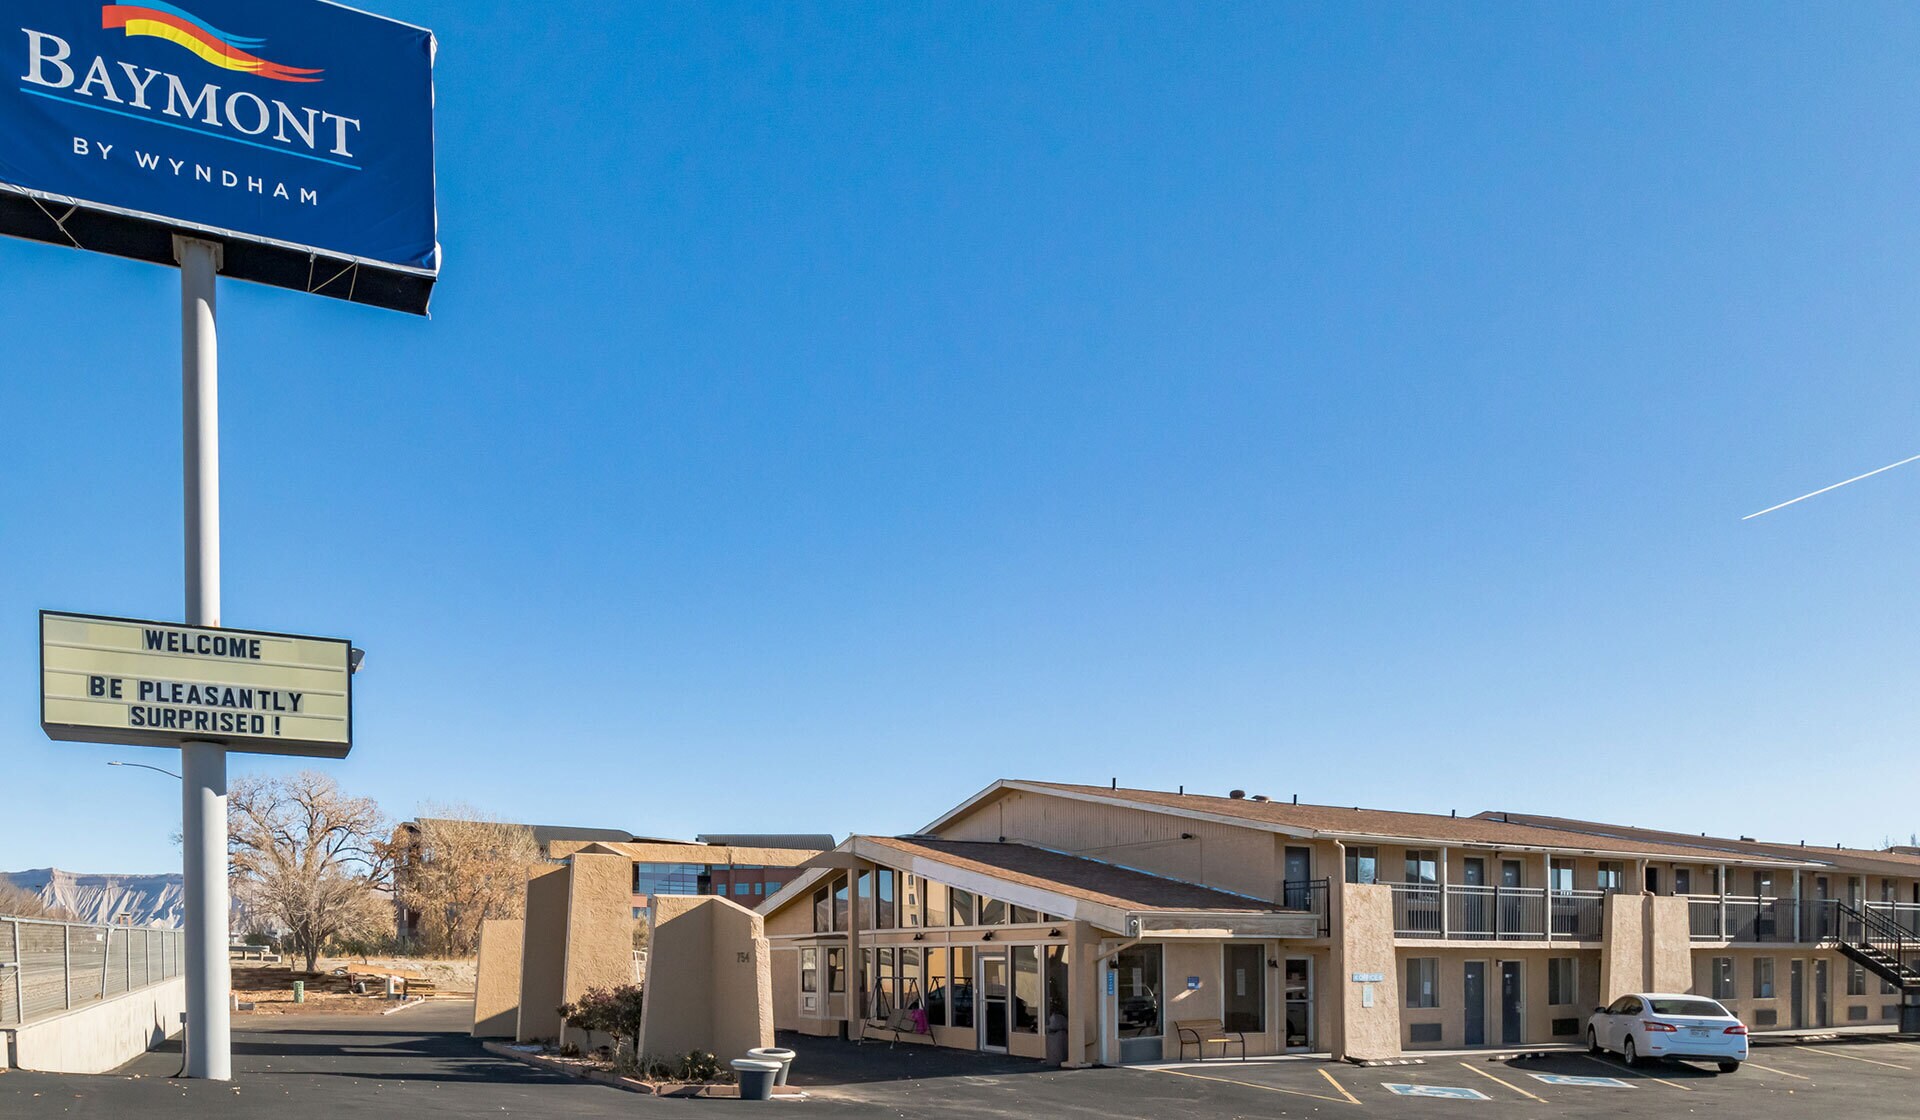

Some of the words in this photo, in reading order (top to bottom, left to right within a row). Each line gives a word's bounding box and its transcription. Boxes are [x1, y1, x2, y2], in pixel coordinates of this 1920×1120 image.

[20, 28, 361, 158] BAYMONT
[73, 137, 113, 160] BY
[135, 150, 318, 206] WYNDHAM
[145, 629, 261, 660] WELCOME
[90, 676, 123, 699] BE
[139, 681, 303, 713] PLEASANTLY
